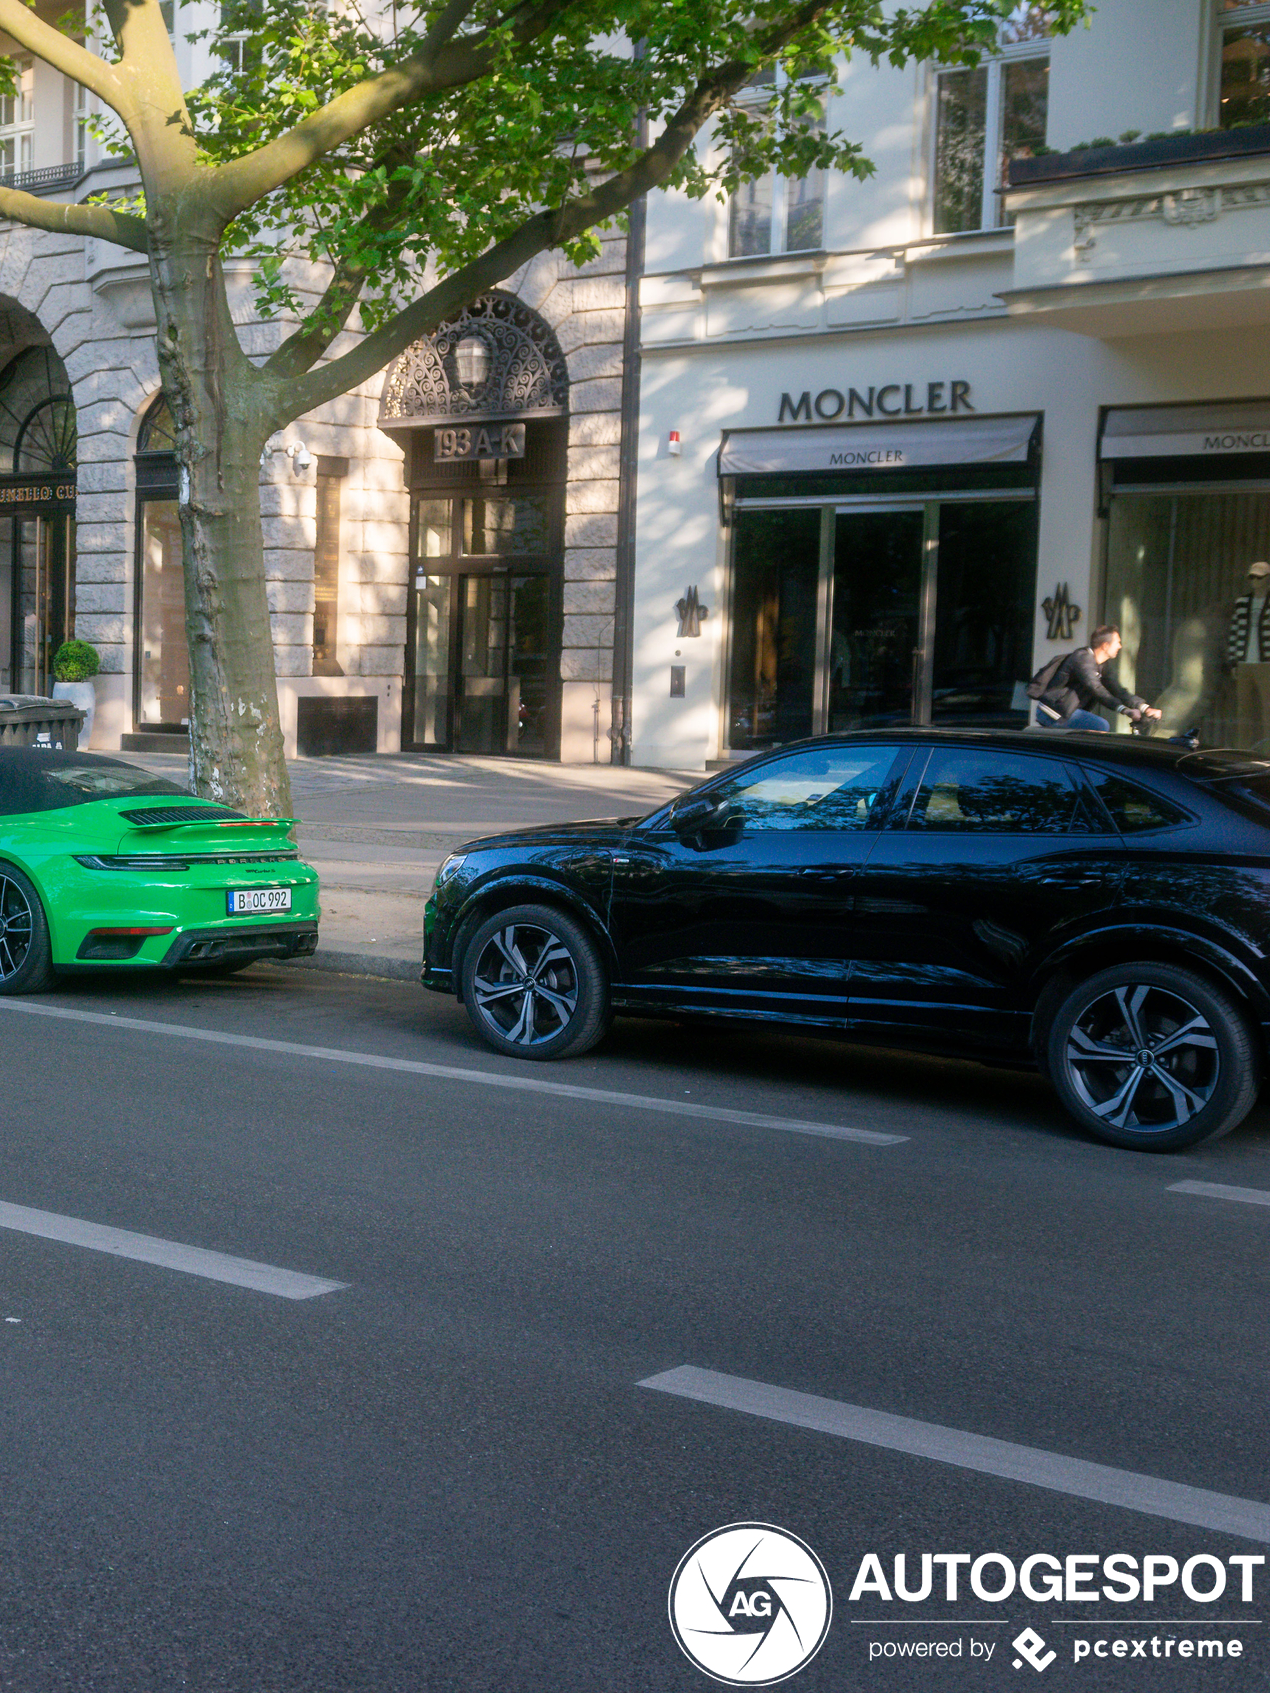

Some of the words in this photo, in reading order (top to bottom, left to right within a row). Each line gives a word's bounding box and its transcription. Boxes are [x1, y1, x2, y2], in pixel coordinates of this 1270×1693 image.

[778, 380, 975, 422] MONCLER
[435, 428, 471, 457] 193
[474, 427, 519, 455] A-K
[830, 450, 903, 465] MONCLER
[56, 484, 79, 500] CU
[238, 894, 246, 909] B
[268, 891, 287, 907] 992
